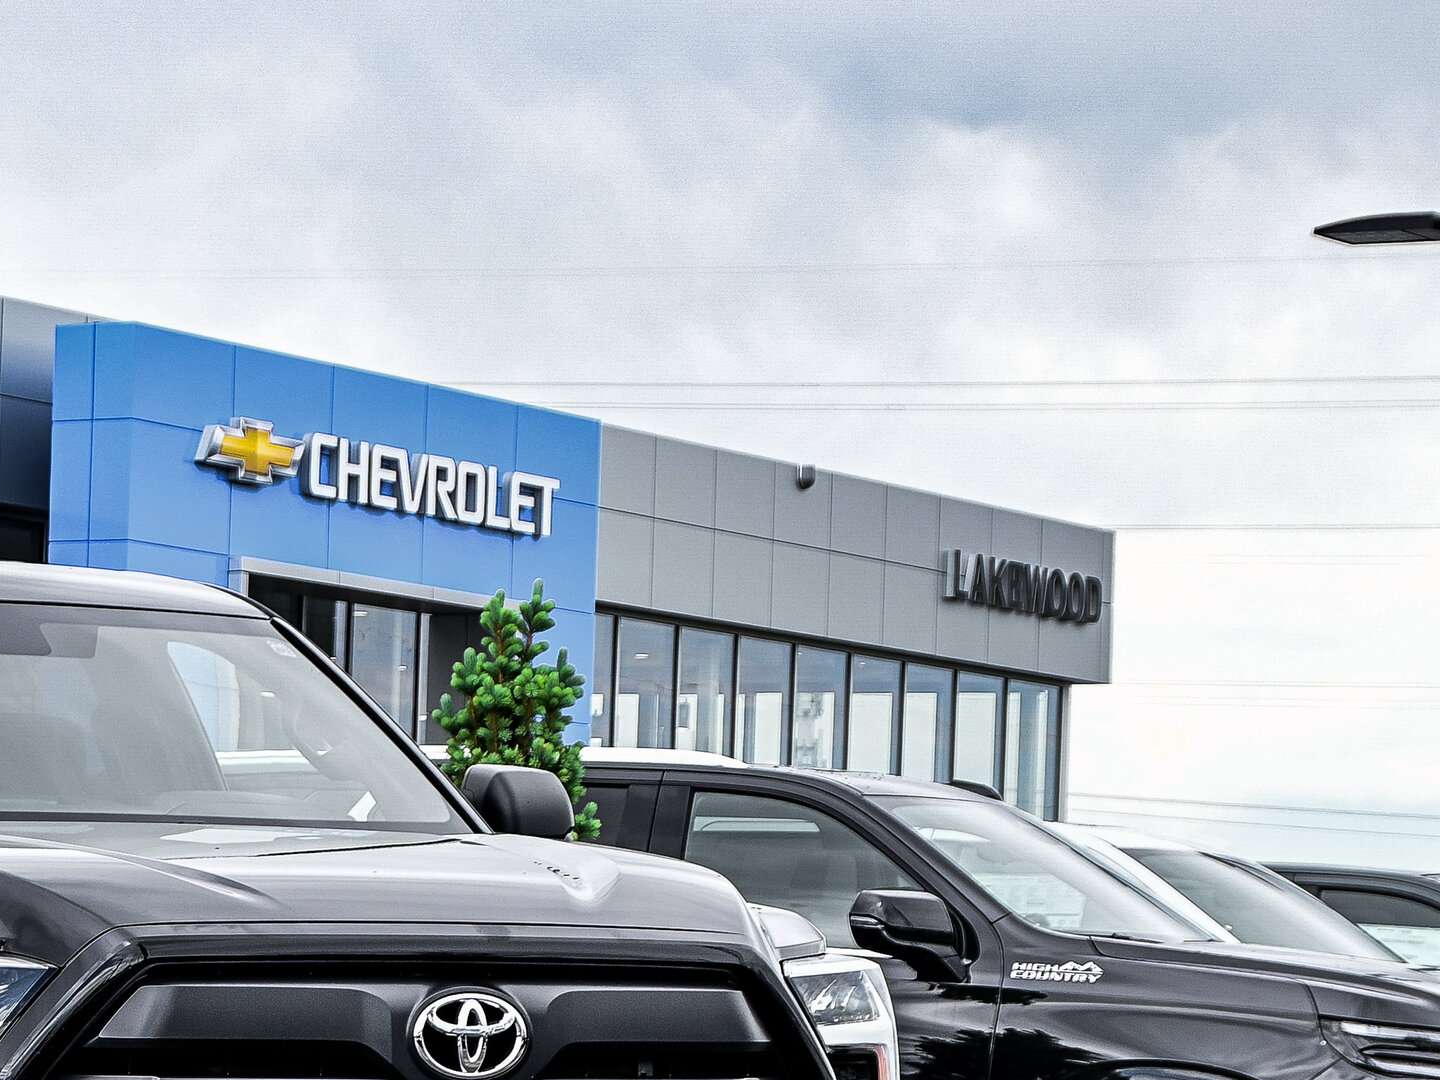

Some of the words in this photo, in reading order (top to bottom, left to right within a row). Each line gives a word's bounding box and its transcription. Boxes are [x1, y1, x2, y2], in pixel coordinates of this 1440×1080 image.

[301, 432, 560, 537] CHEVROLET
[944, 549, 1103, 624] LAKEWOOD
[1010, 970, 1102, 984] COUNTRY
[1012, 962, 1061, 972] HIGH
